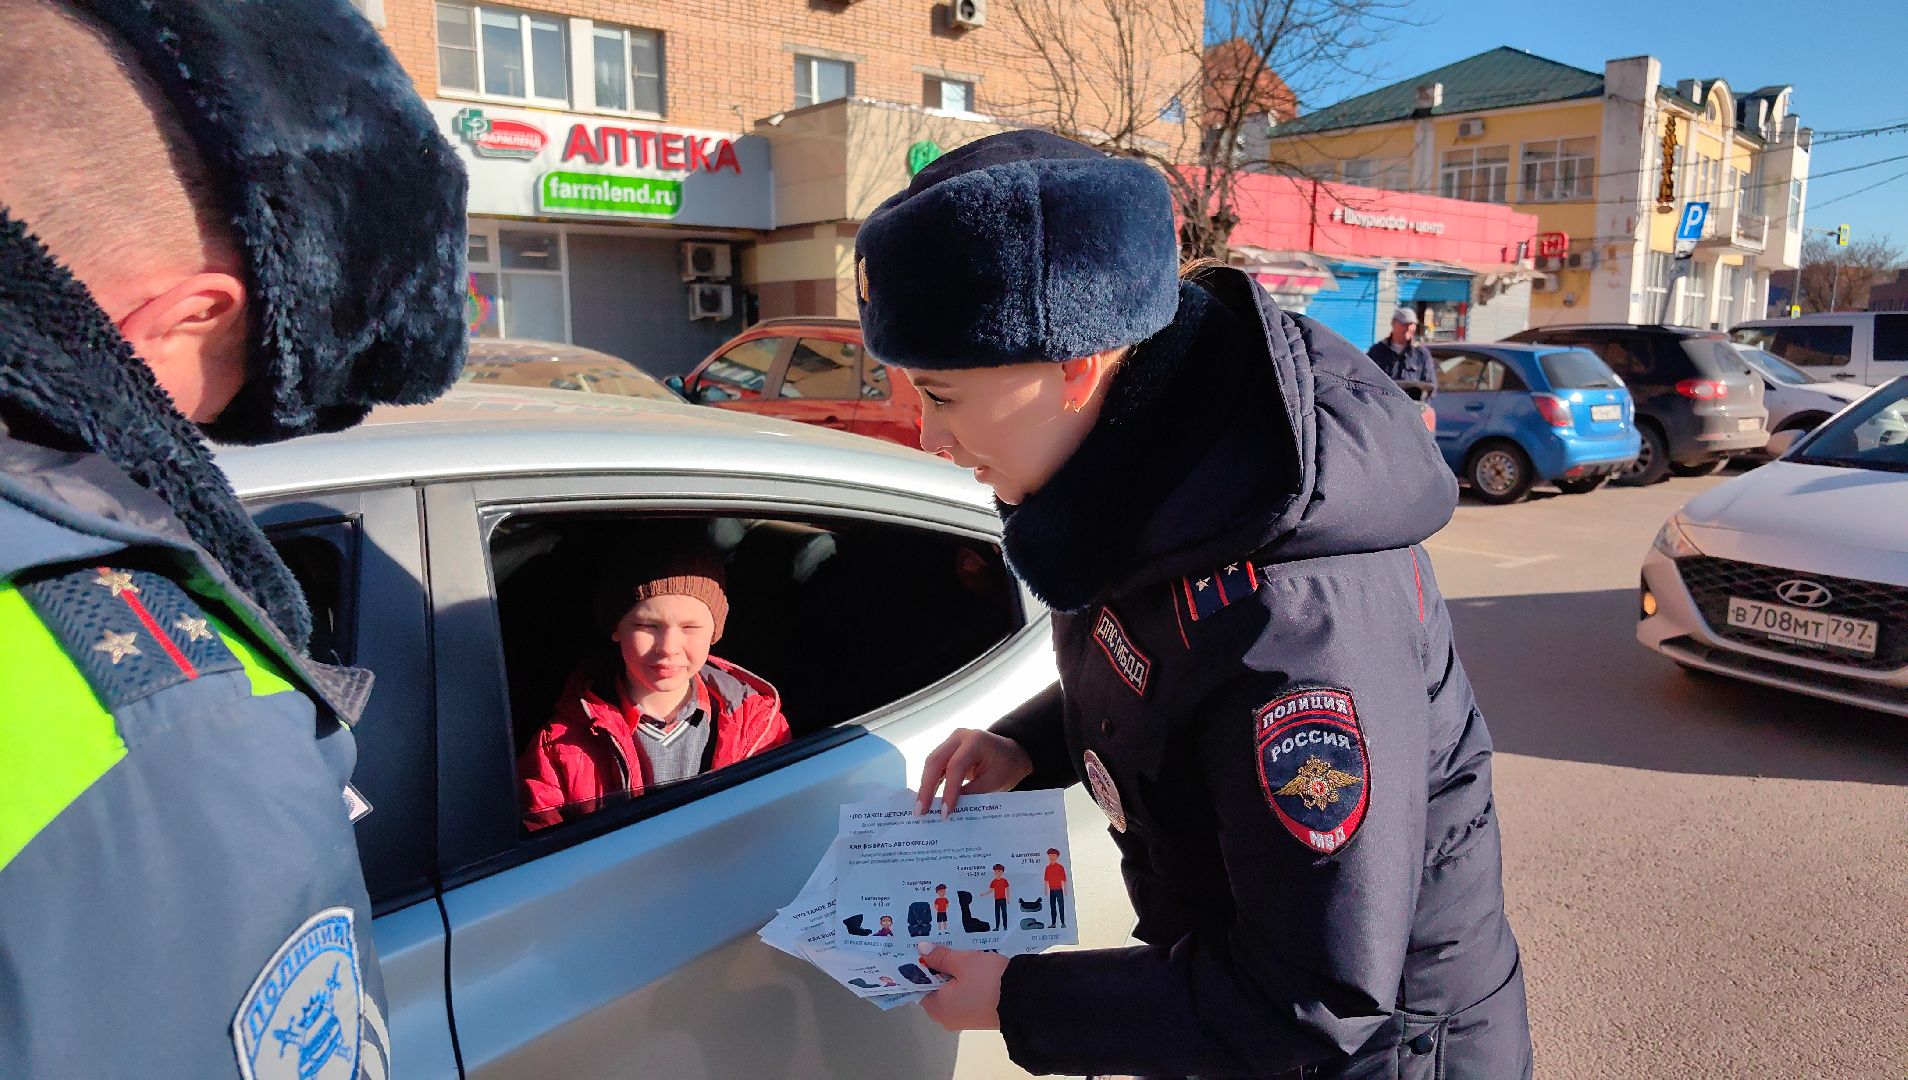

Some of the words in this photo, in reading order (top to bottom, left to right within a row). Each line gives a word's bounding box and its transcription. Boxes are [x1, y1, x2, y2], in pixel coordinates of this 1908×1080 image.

[563, 123, 742, 175] АПТЕКА
[548, 175, 678, 207] farmlend.ru
[1684, 205, 1703, 237] P
[1830, 618, 1869, 640] 797
[1097, 616, 1118, 648] ДПС
[1113, 635, 1145, 689] ГИБДД
[1262, 696, 1348, 729] ПОЛИЦИЯ
[1270, 729, 1351, 763] РОССИЯ
[1308, 825, 1346, 850] МВД
[247, 922, 349, 1038] ПОЛИЦИЯ
